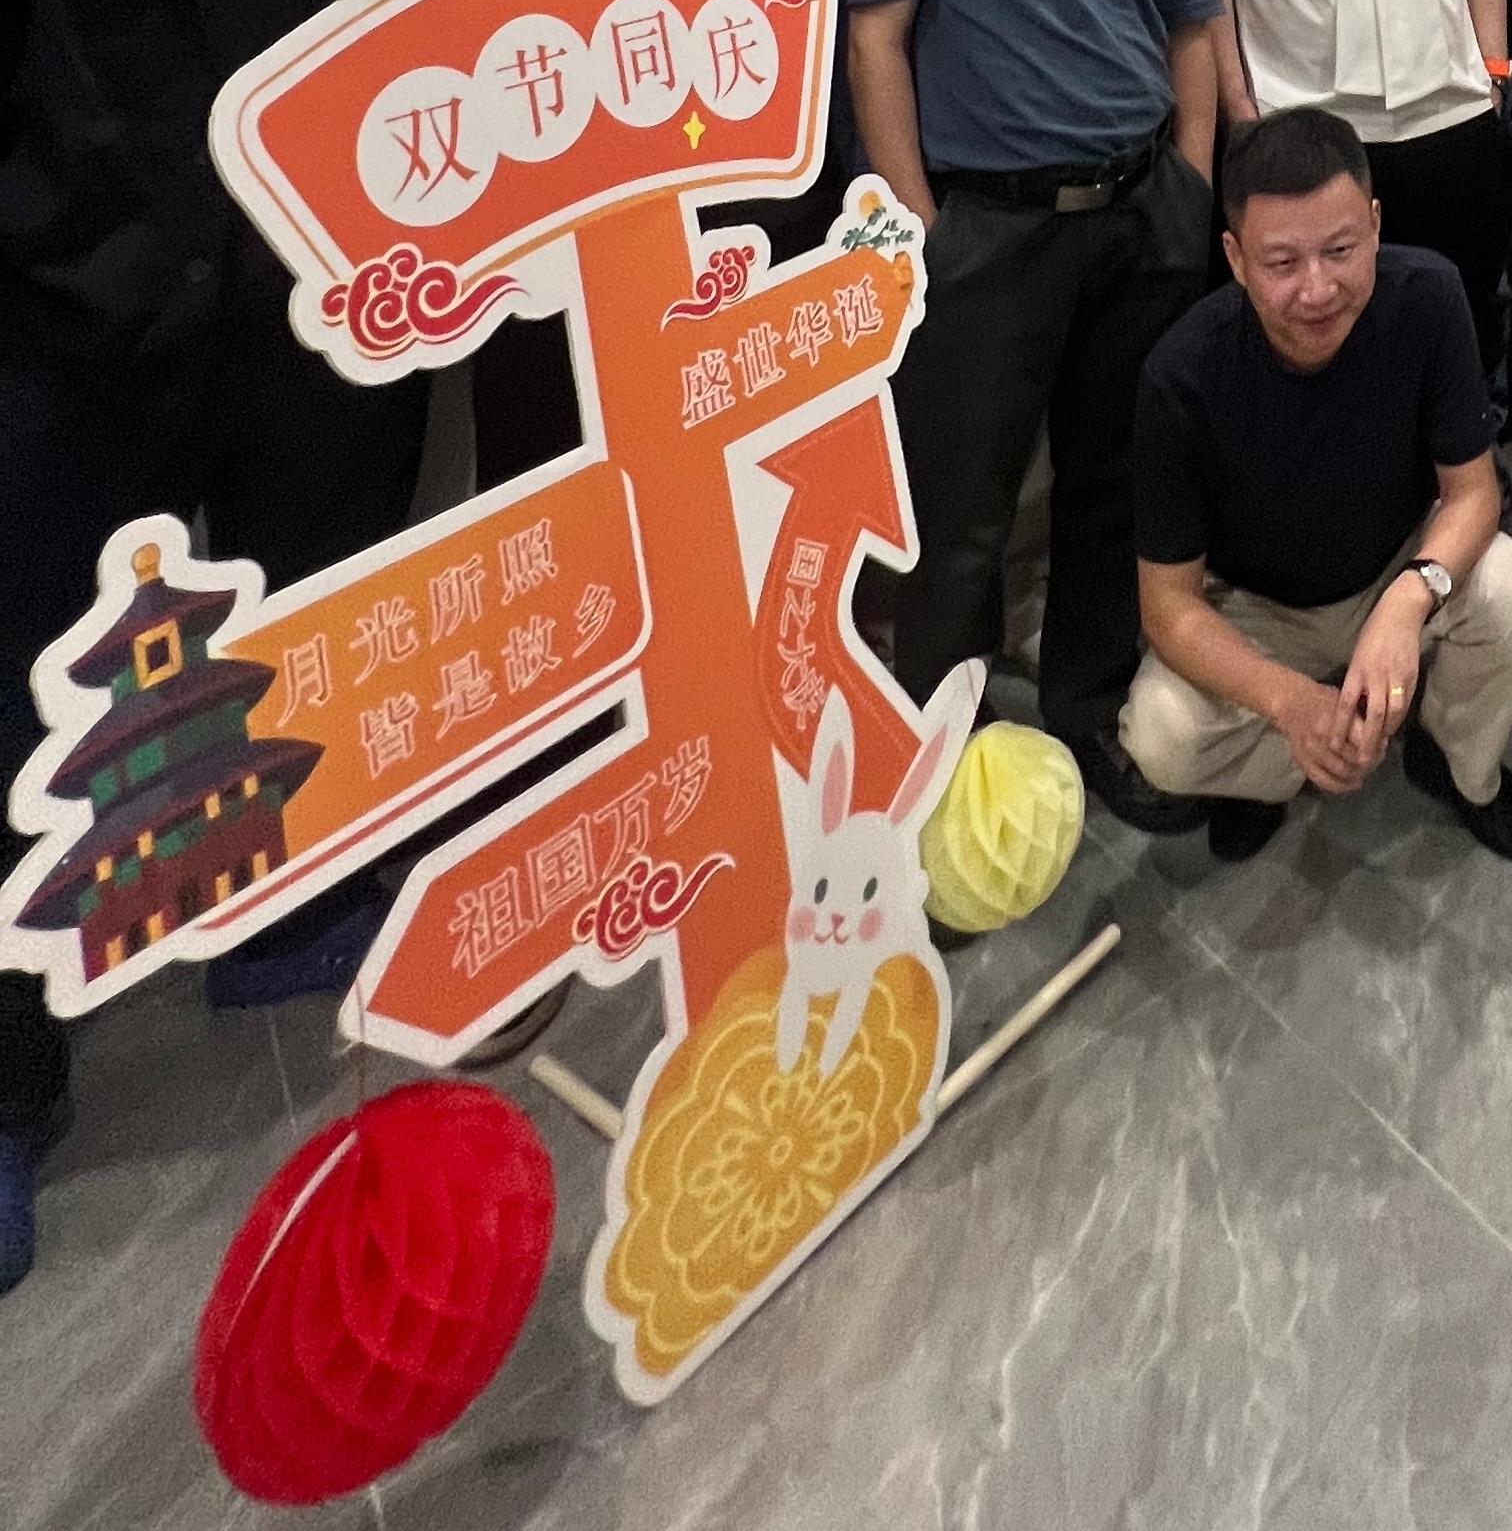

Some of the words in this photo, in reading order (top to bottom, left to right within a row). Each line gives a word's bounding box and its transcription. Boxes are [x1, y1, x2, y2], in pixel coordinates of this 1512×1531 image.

[384, 9, 767, 203] 双节同庆
[681, 273, 885, 430] 盛世华诞
[277, 518, 558, 729] 月光所照
[359, 583, 617, 780] 皆是故乡
[448, 735, 713, 979] 祖国万岁
